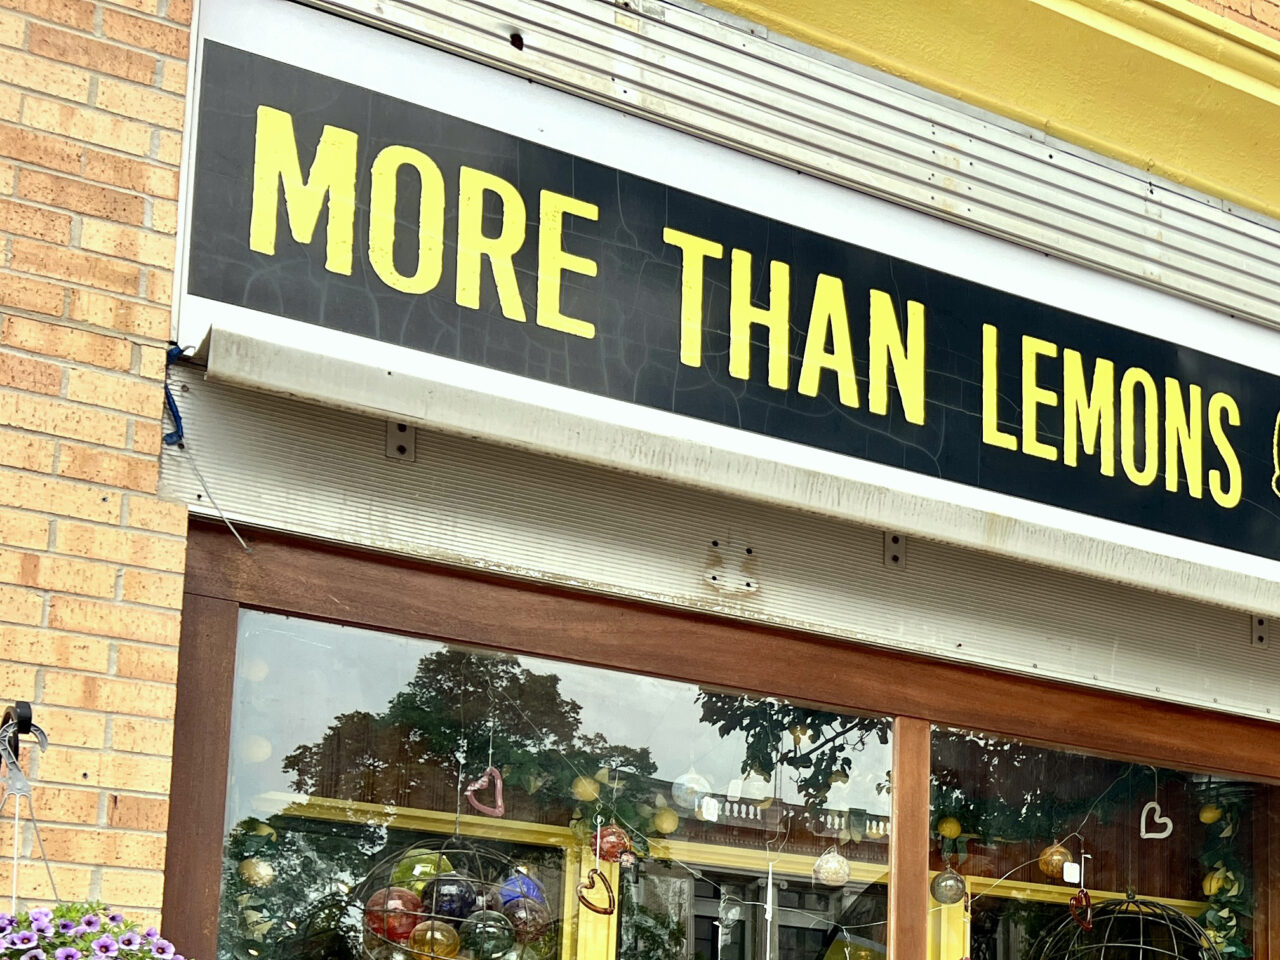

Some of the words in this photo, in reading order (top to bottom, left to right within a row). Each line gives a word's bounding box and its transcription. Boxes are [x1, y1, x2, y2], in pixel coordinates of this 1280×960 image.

[249, 105, 599, 338] MORE
[663, 227, 925, 426] THAN
[980, 323, 1242, 508] LEMONS
